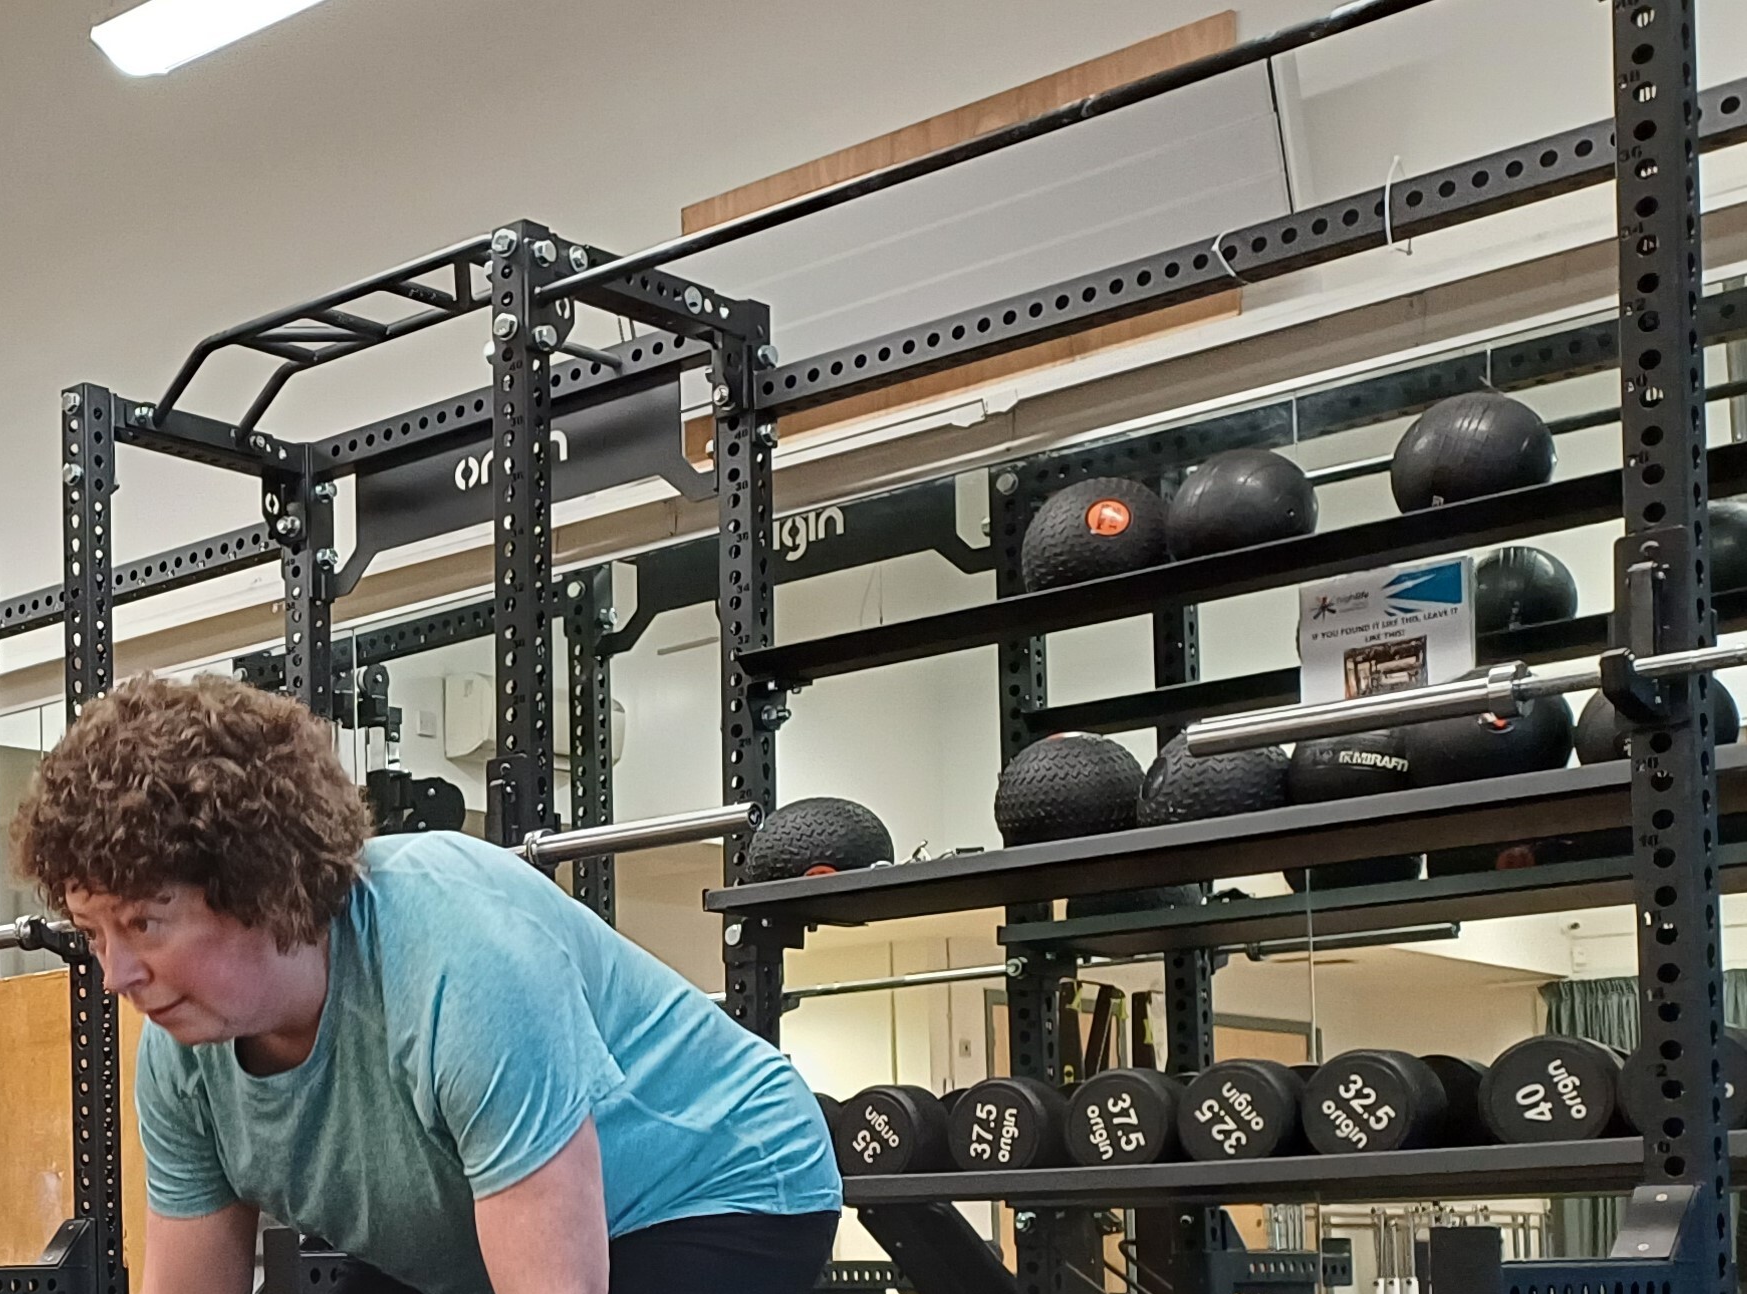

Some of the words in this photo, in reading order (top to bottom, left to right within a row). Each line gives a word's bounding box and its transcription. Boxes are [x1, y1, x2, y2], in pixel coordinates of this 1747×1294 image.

[455, 429, 568, 491] orn
[773, 505, 844, 561] igin
[1321, 631, 1339, 640] YOU
[1340, 625, 1370, 636] FOUND
[1382, 619, 1398, 629] LIKE
[1424, 610, 1448, 620] LEAVE
[1365, 634, 1381, 643] LIKE
[1221, 1081, 1264, 1132] origin
[1338, 1074, 1396, 1131] 32.5
[1516, 1083, 1553, 1123] 40
[1547, 1059, 1587, 1120] origin
[853, 1130, 881, 1163] 35
[864, 1105, 899, 1148] origin
[969, 1103, 997, 1160] 37.5
[998, 1108, 1019, 1163] origin
[1087, 1105, 1113, 1161] origin
[1108, 1093, 1146, 1151] 37.5
[1194, 1098, 1248, 1155] 32.5
[1322, 1099, 1369, 1149] origin
